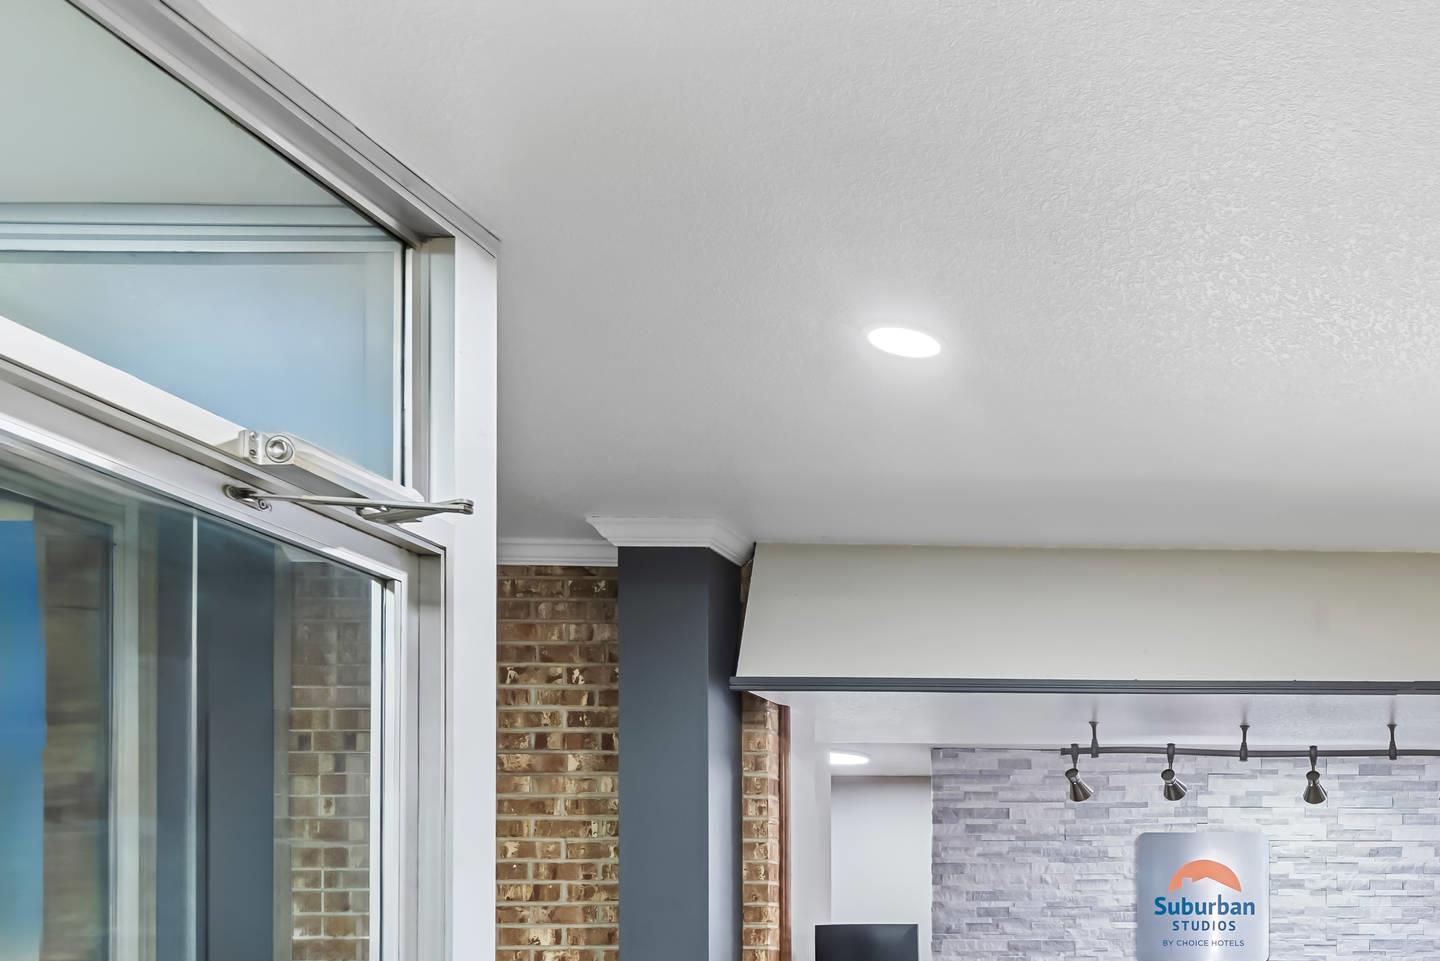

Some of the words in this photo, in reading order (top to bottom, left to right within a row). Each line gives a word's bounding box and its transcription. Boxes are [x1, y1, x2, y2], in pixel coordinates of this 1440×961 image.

[1154, 894, 1255, 916] Suburban
[1172, 920, 1236, 932] STUDIOS
[1162, 939, 1174, 947] BY
[1176, 939, 1209, 947] CHOICE
[1211, 939, 1245, 947] HOTELS
